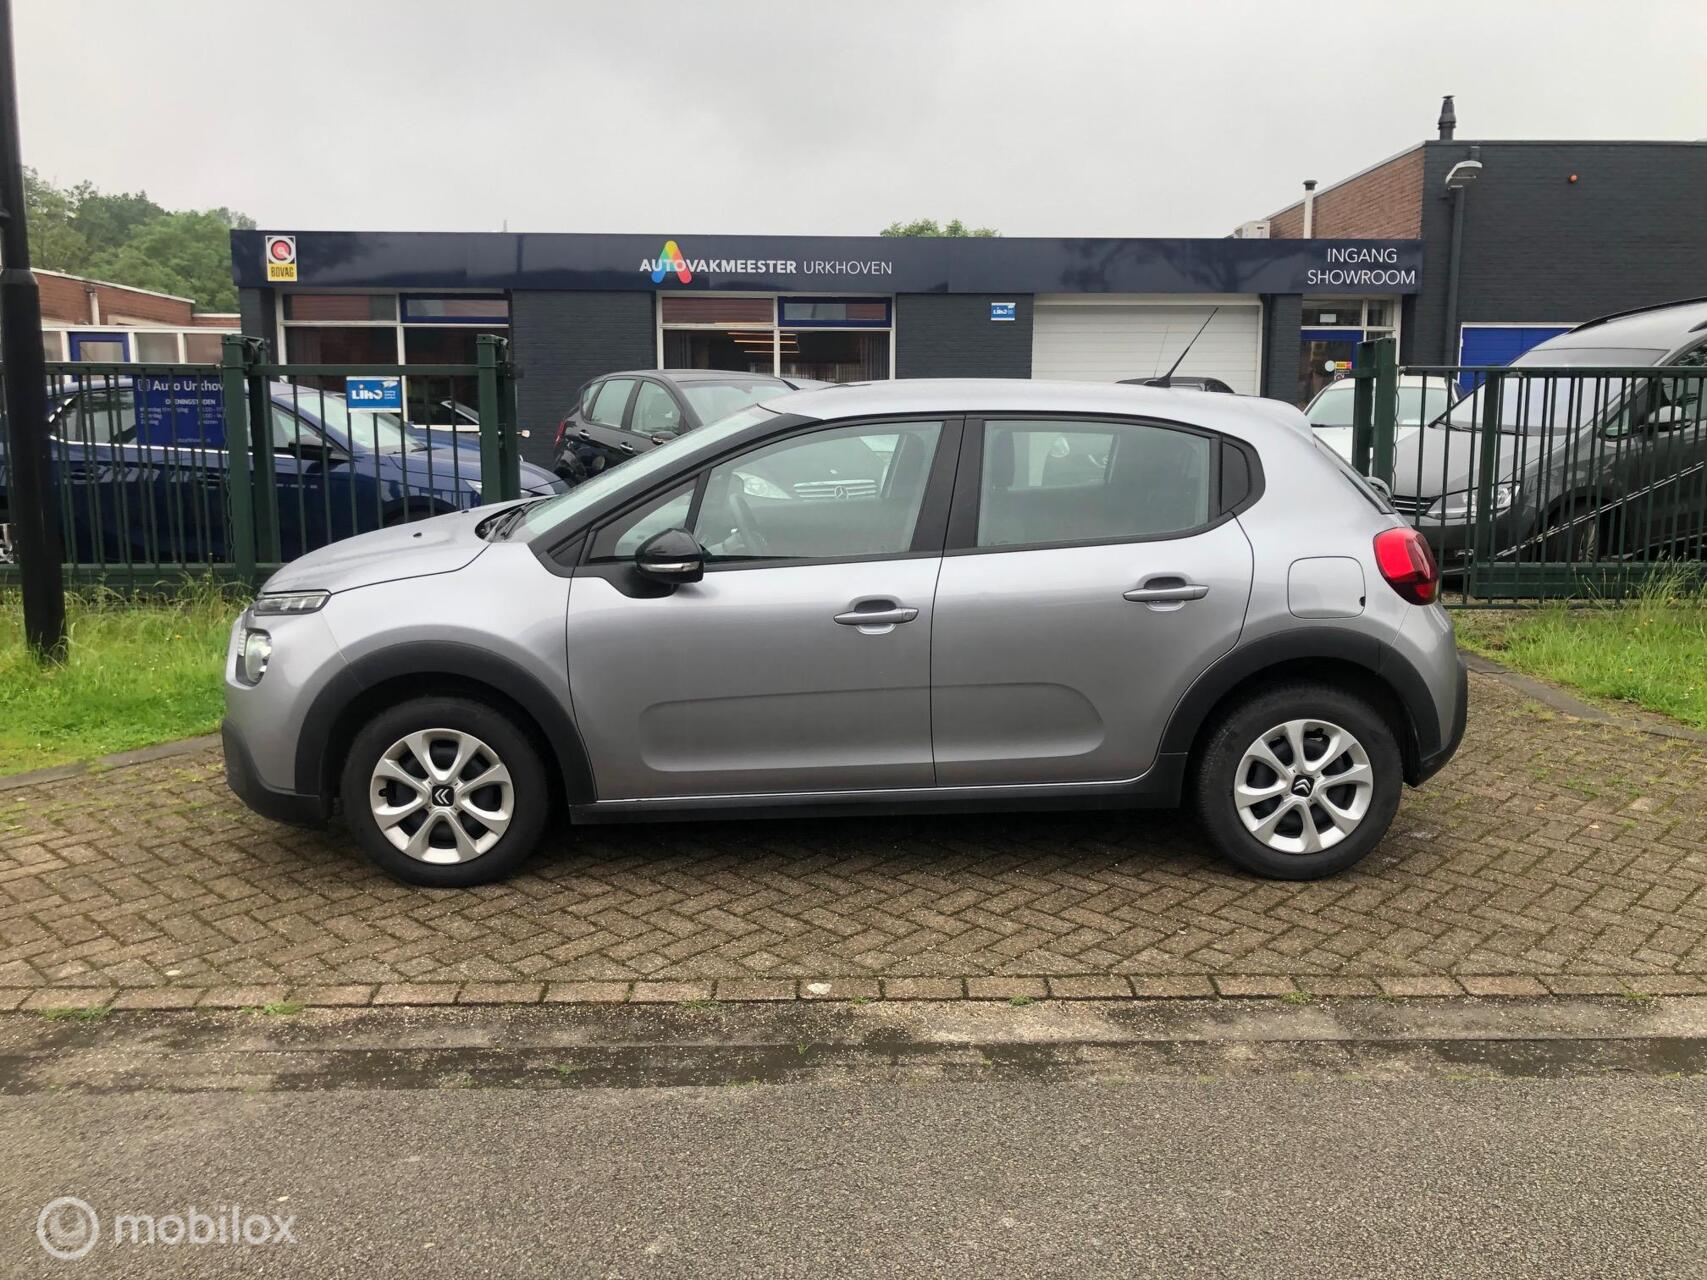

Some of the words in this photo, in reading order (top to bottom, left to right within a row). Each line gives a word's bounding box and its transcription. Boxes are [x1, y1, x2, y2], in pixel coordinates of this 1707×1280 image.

[1327, 248, 1397, 263] INGANG
[271, 266, 294, 278] BOVAG
[639, 258, 797, 274] AUTOVAKMEESTER
[803, 261, 892, 275] URKHOVEN
[1307, 269, 1416, 285] SHOWROOM
[153, 380, 181, 392] Auo
